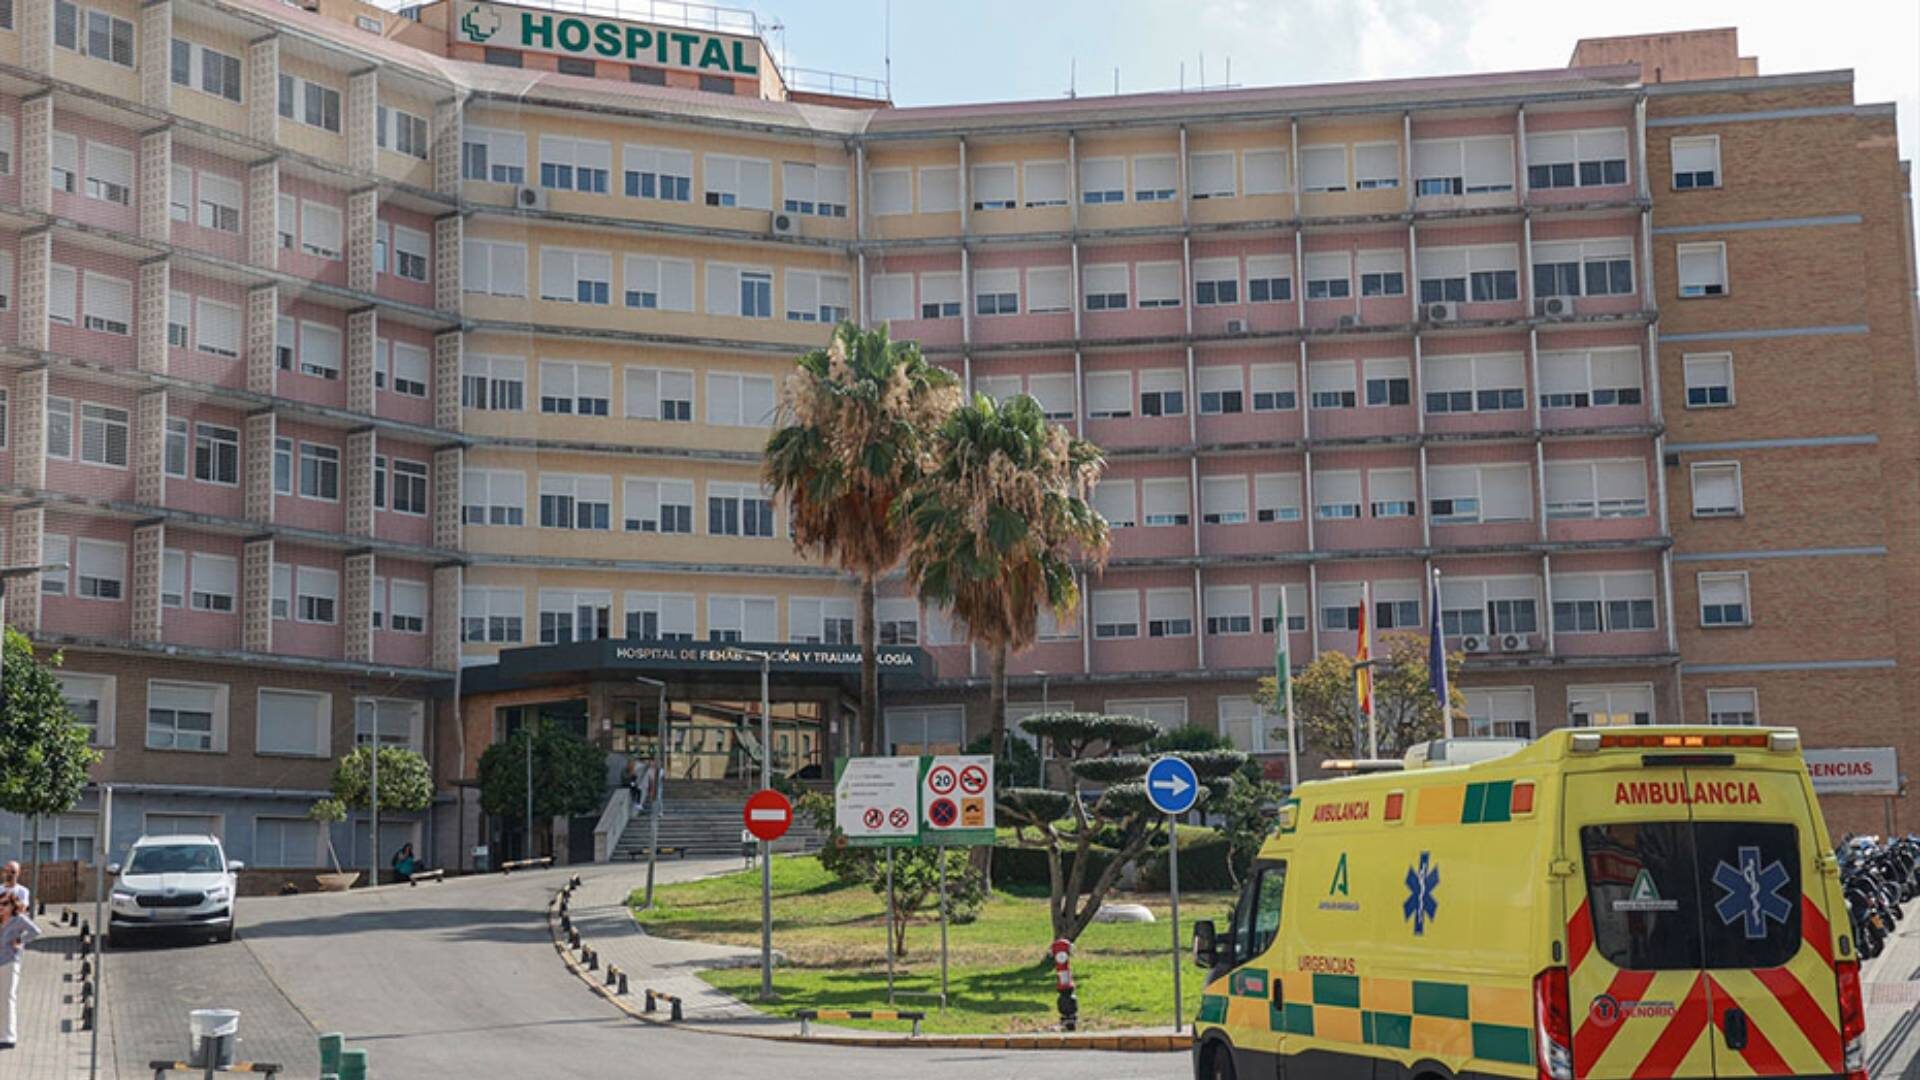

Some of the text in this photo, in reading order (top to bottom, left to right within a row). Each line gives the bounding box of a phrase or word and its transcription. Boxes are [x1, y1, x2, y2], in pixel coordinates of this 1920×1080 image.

[520, 12, 758, 75] HOSPITAL
[616, 647, 677, 660] HOSPITAL
[680, 649, 697, 660] DE
[803, 651, 811, 662] Y
[814, 651, 913, 665] TRAUMALOGÍA
[1805, 761, 1873, 777] GENCIAS
[934, 774, 951, 787] 20
[1614, 782, 1762, 805] AMBULANCIA
[1313, 801, 1369, 822] AMBULANCIA
[1298, 956, 1355, 974] URGENCIAS
